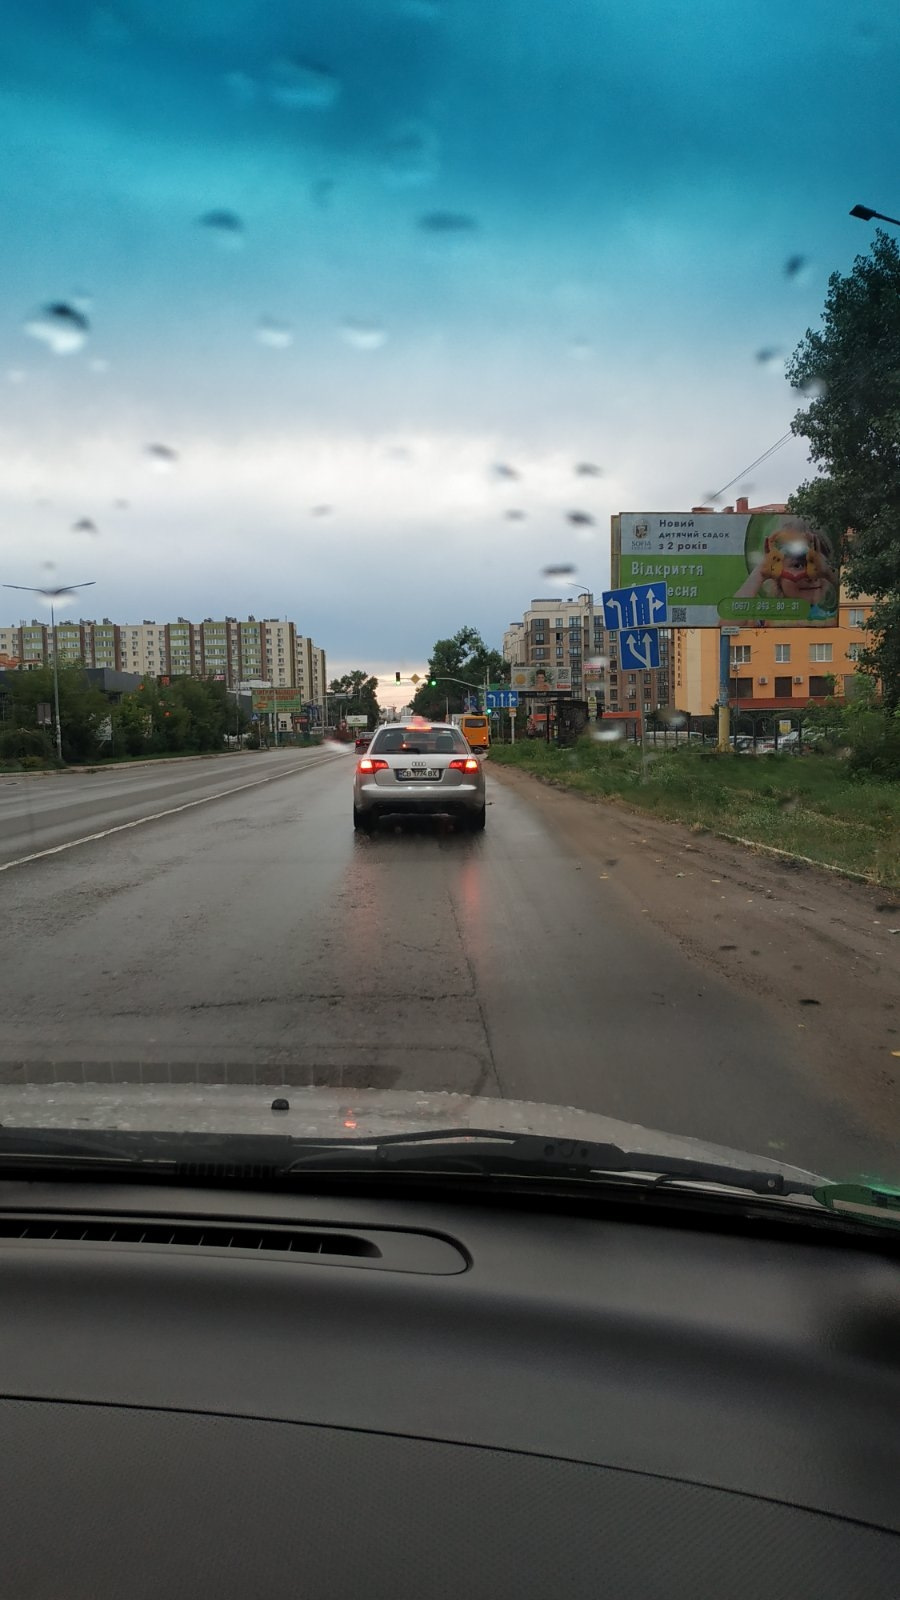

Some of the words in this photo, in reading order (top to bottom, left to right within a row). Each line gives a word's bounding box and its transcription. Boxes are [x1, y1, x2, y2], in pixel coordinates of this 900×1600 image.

[660, 519, 695, 528] Новий
[668, 542, 674, 550] 2
[677, 541, 708, 552] років
[631, 561, 703, 578] Відкриття
